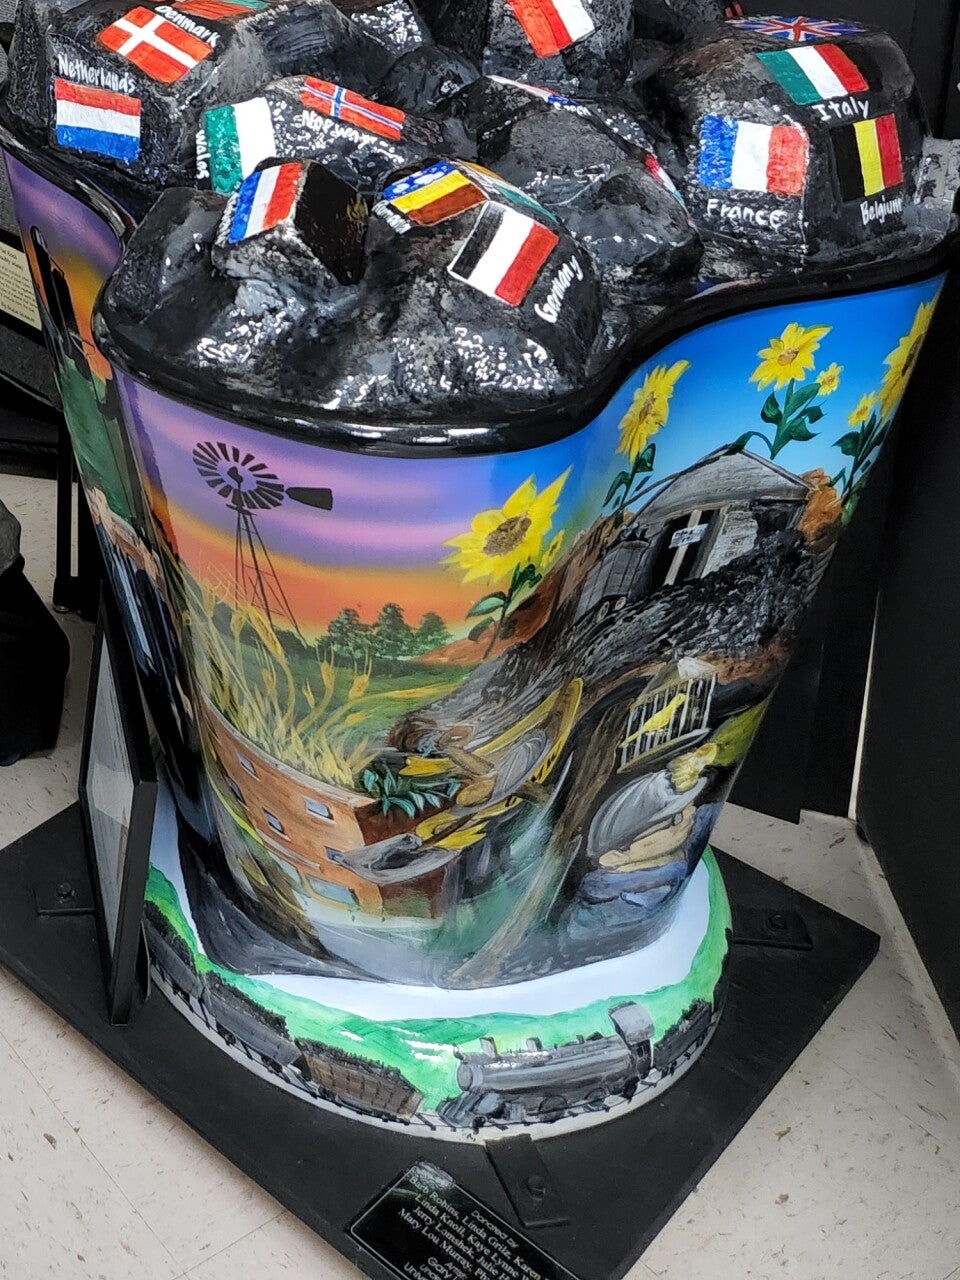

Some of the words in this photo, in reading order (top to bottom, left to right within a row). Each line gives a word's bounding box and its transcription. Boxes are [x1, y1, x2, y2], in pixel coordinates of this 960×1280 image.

[154, 5, 221, 48] Denmark
[57, 53, 136, 93] Netherlands
[812, 97, 870, 122] Italy
[706, 198, 789, 229] France
[860, 195, 903, 226] Belgium
[534, 255, 584, 324] Germany
[398, 1208, 422, 1229] Mary
[421, 1226, 439, 1245] Lou
[409, 1176, 429, 1194] Barb
[430, 1191, 460, 1220] Robins,
[462, 1216, 487, 1240] Linda
[513, 1255, 541, 1280] Karen
[413, 1206, 436, 1225] Jerry
[476, 1256, 499, 1276] Julie
[415, 1194, 440, 1216] Linda
[467, 1234, 491, 1256] Kaye
[491, 1253, 520, 1278] Lynne
[427, 1257, 452, 1279] Gary
